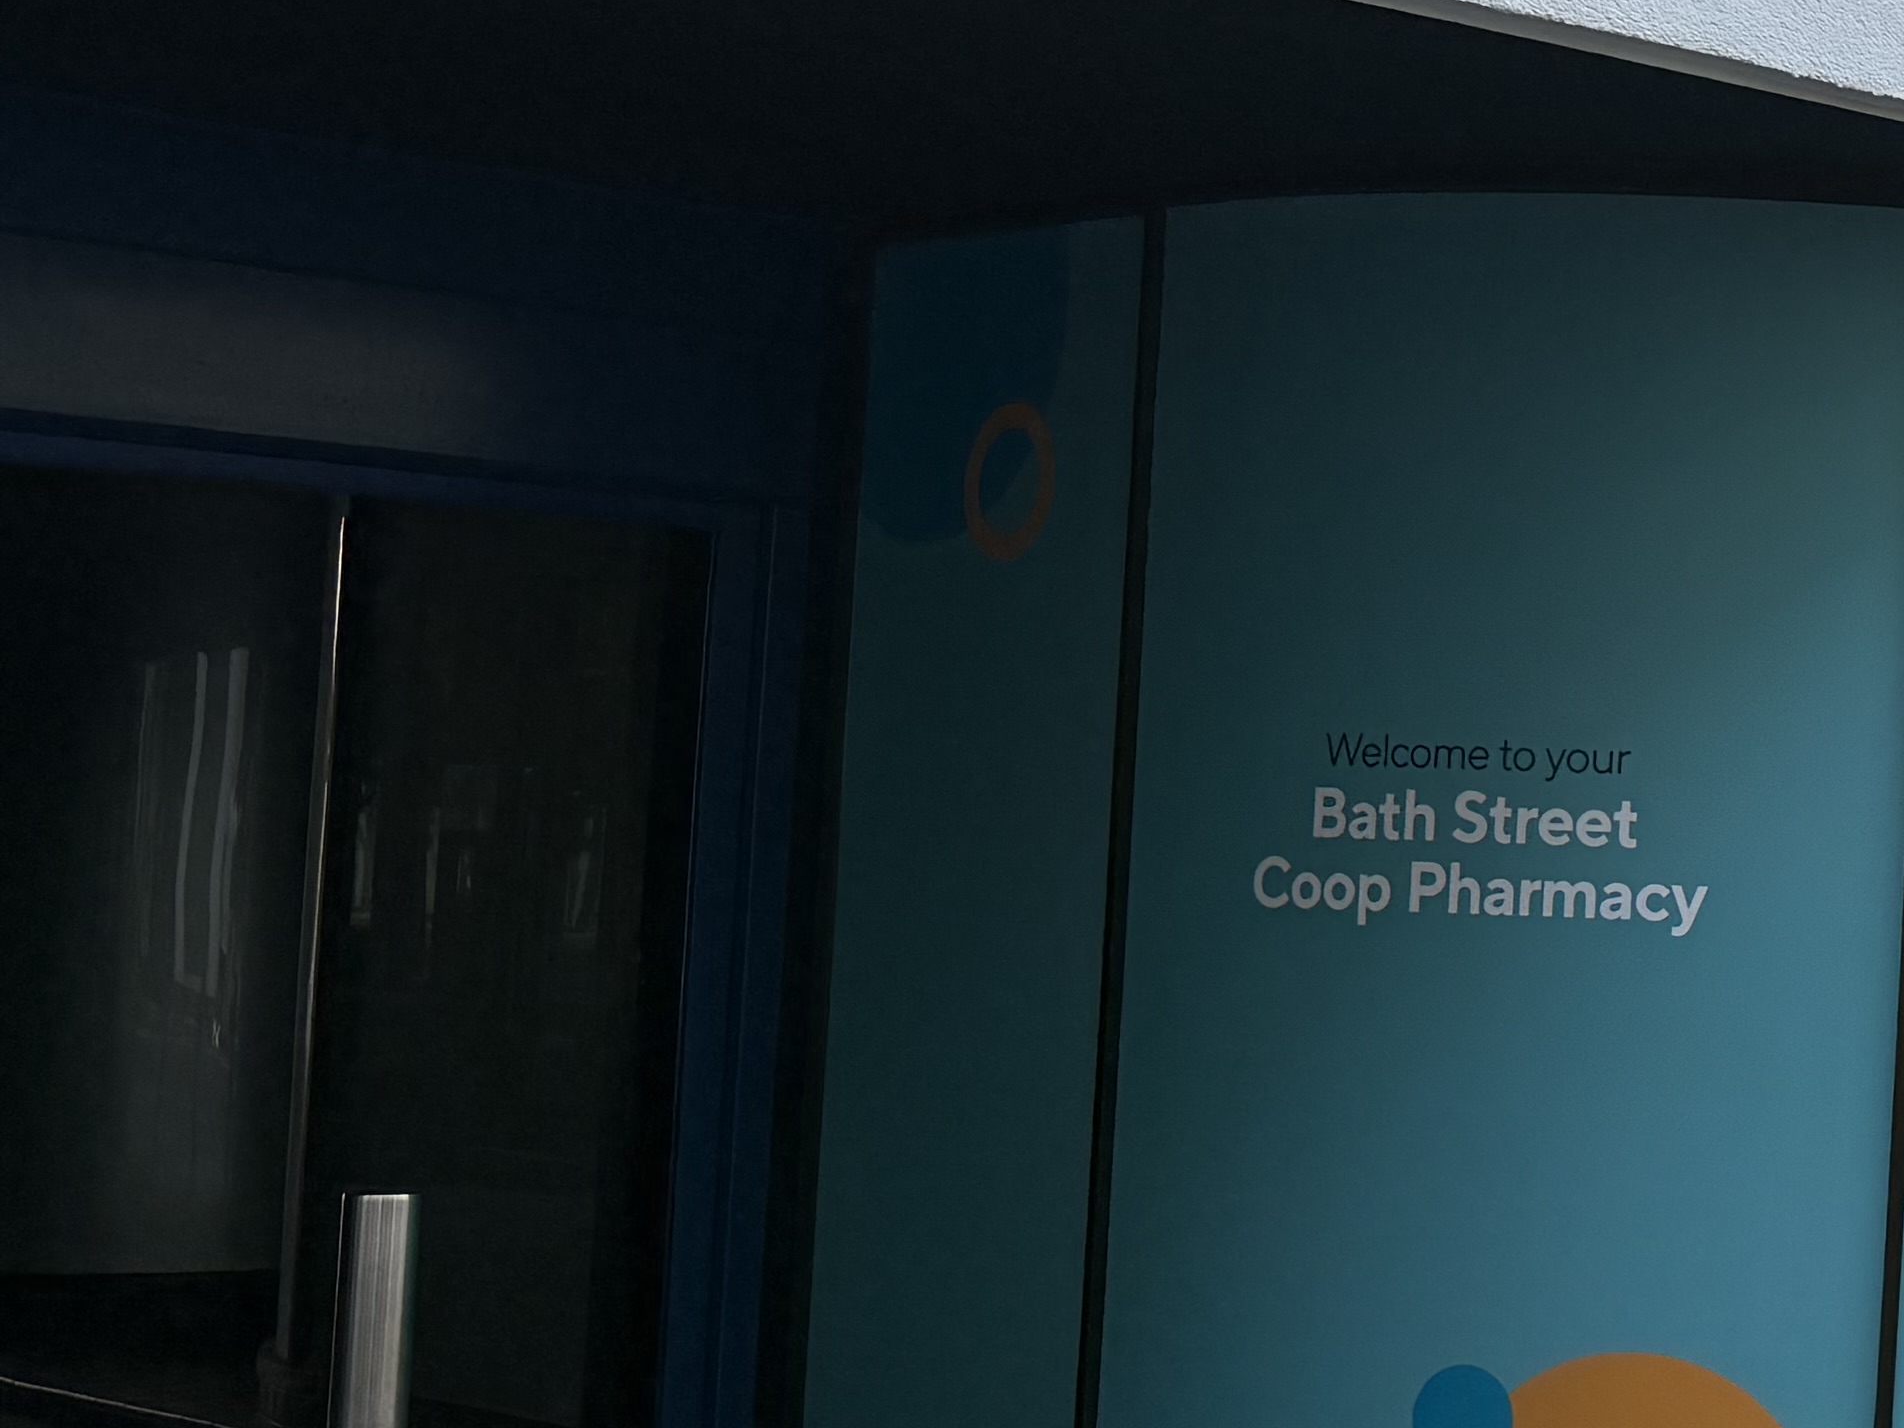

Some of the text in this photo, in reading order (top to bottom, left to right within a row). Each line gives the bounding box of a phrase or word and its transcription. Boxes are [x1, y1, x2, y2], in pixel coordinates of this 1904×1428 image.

[1326, 733, 1631, 781] Welcome to your
[1313, 787, 1638, 849] Bath Street
[1253, 856, 1709, 937] Coop Pharmacy
